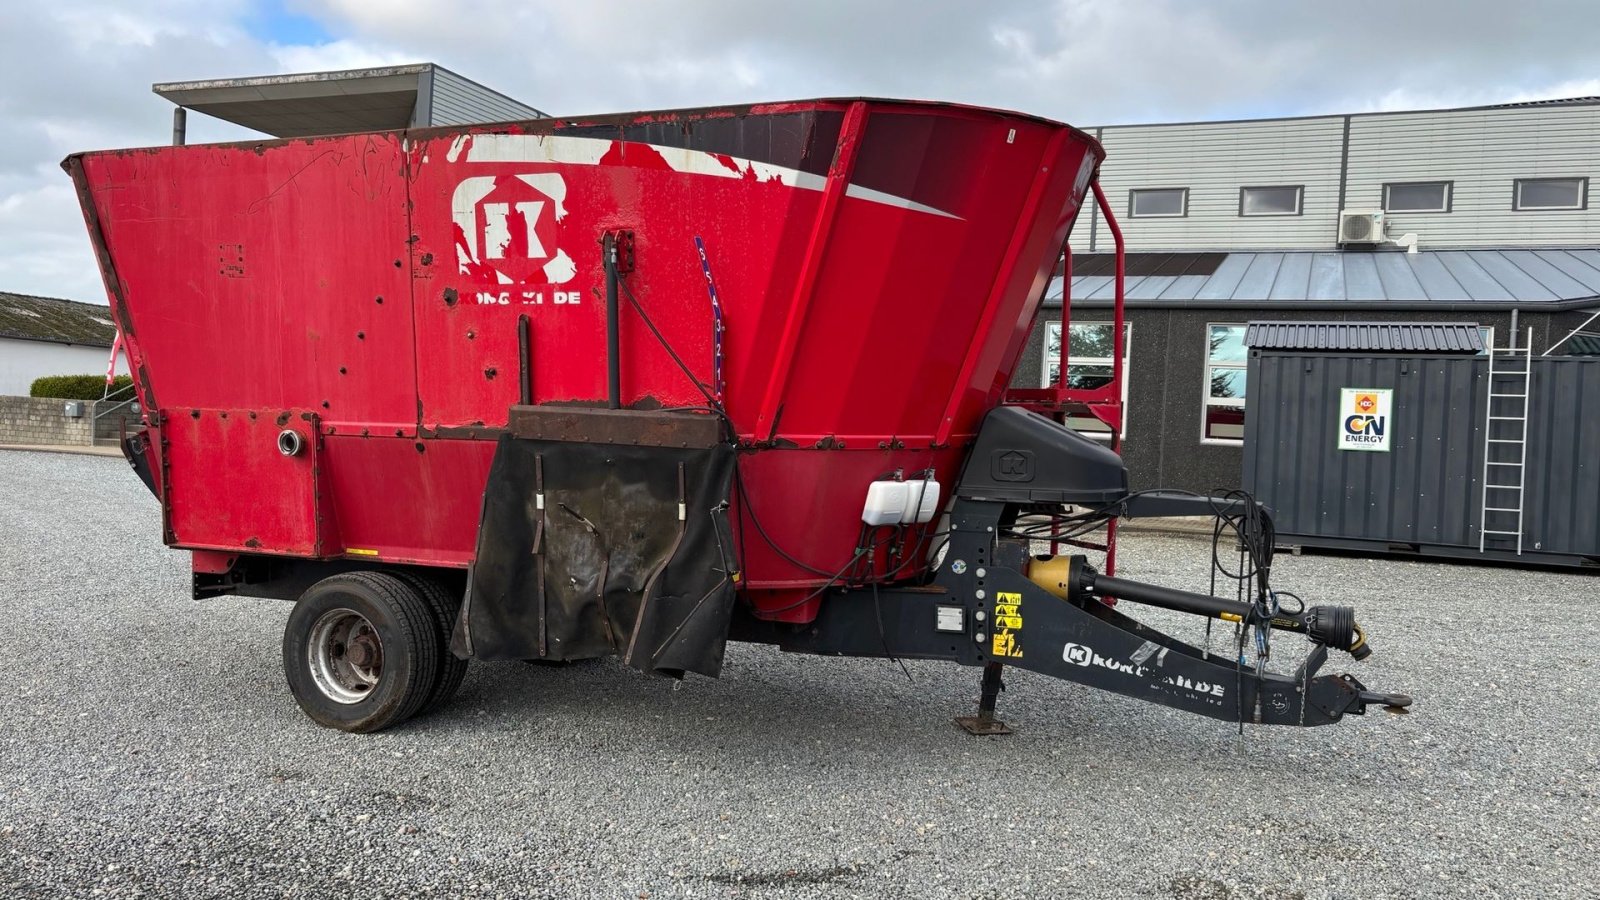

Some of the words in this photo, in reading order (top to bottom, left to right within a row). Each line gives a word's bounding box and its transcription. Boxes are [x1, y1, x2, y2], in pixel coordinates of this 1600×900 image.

[712, 295, 719, 308] 4
[716, 319, 721, 332] 3
[716, 343, 721, 356] 2
[1344, 415, 1385, 435] CN
[1345, 434, 1384, 443] ENERGY
